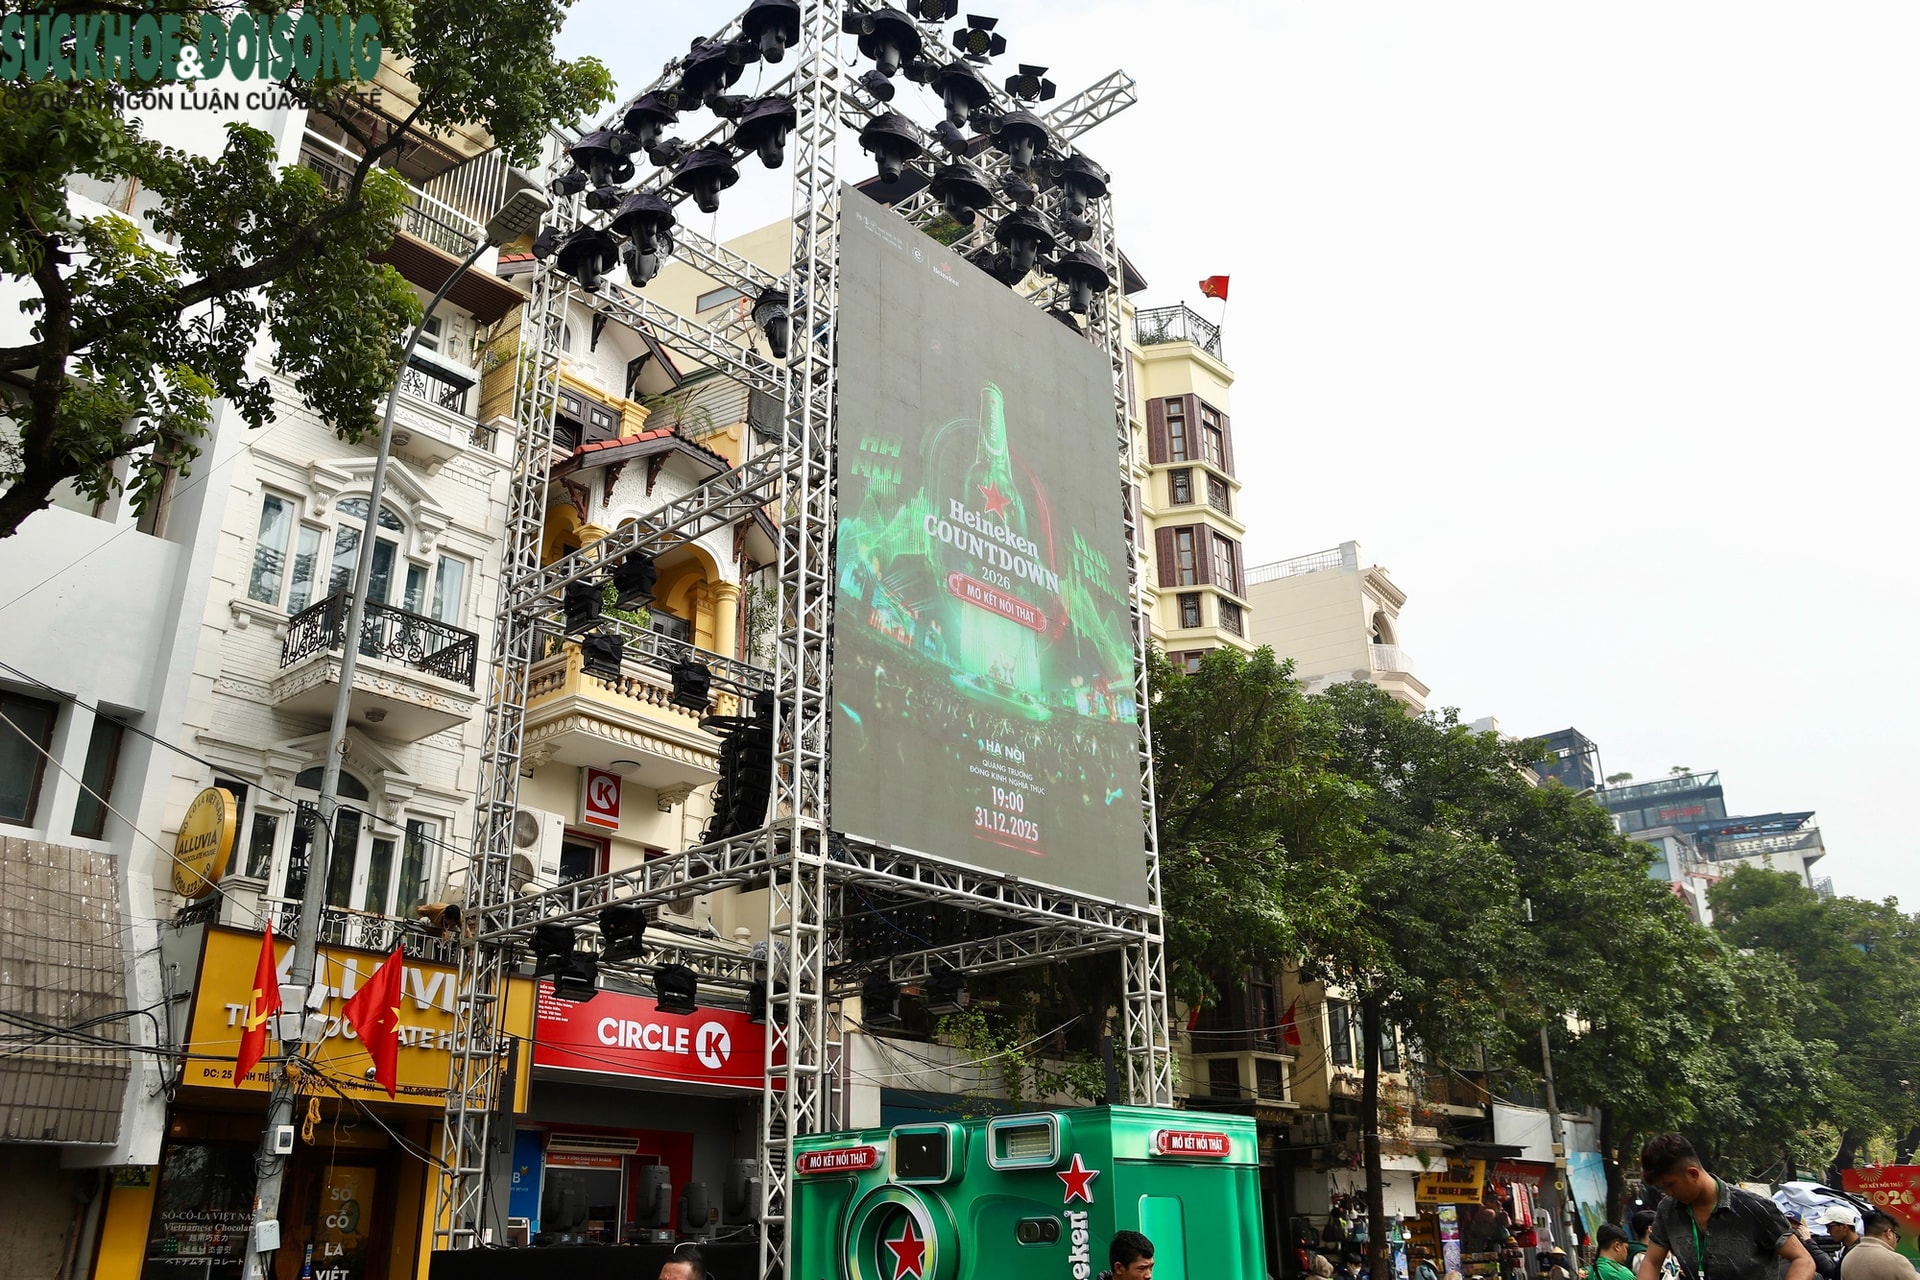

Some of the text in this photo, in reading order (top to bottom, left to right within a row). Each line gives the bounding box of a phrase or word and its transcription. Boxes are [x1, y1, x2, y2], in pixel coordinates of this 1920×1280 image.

[949, 497, 1039, 559] Heineken
[924, 514, 1060, 595] COUNTDOWN
[982, 566, 1011, 590] 2026
[967, 582, 1036, 624] MỞ KẾT NỐI THẬT
[986, 739, 1002, 755] HÀ
[990, 771, 1008, 783] KINH
[991, 785, 1024, 813] 19:00
[975, 806, 1039, 841] 31.12.2025
[178, 829, 218, 855] ALLUVIA
[597, 1017, 690, 1055] CIRCLE
[203, 1068, 220, 1079] ĐC:
[222, 1069, 232, 1079] 25
[1171, 1133, 1223, 1153] MỞ KẾT NỐI THẬT
[809, 1150, 867, 1168] MỞ KẾT NỐI THẬT
[162, 1209, 210, 1220] SÔ-CÔ-LA
[211, 1211, 236, 1223] VIỆT
[326, 1210, 349, 1228] CÔ
[164, 1222, 212, 1232] Vietnamese
[324, 1242, 344, 1256] LA
